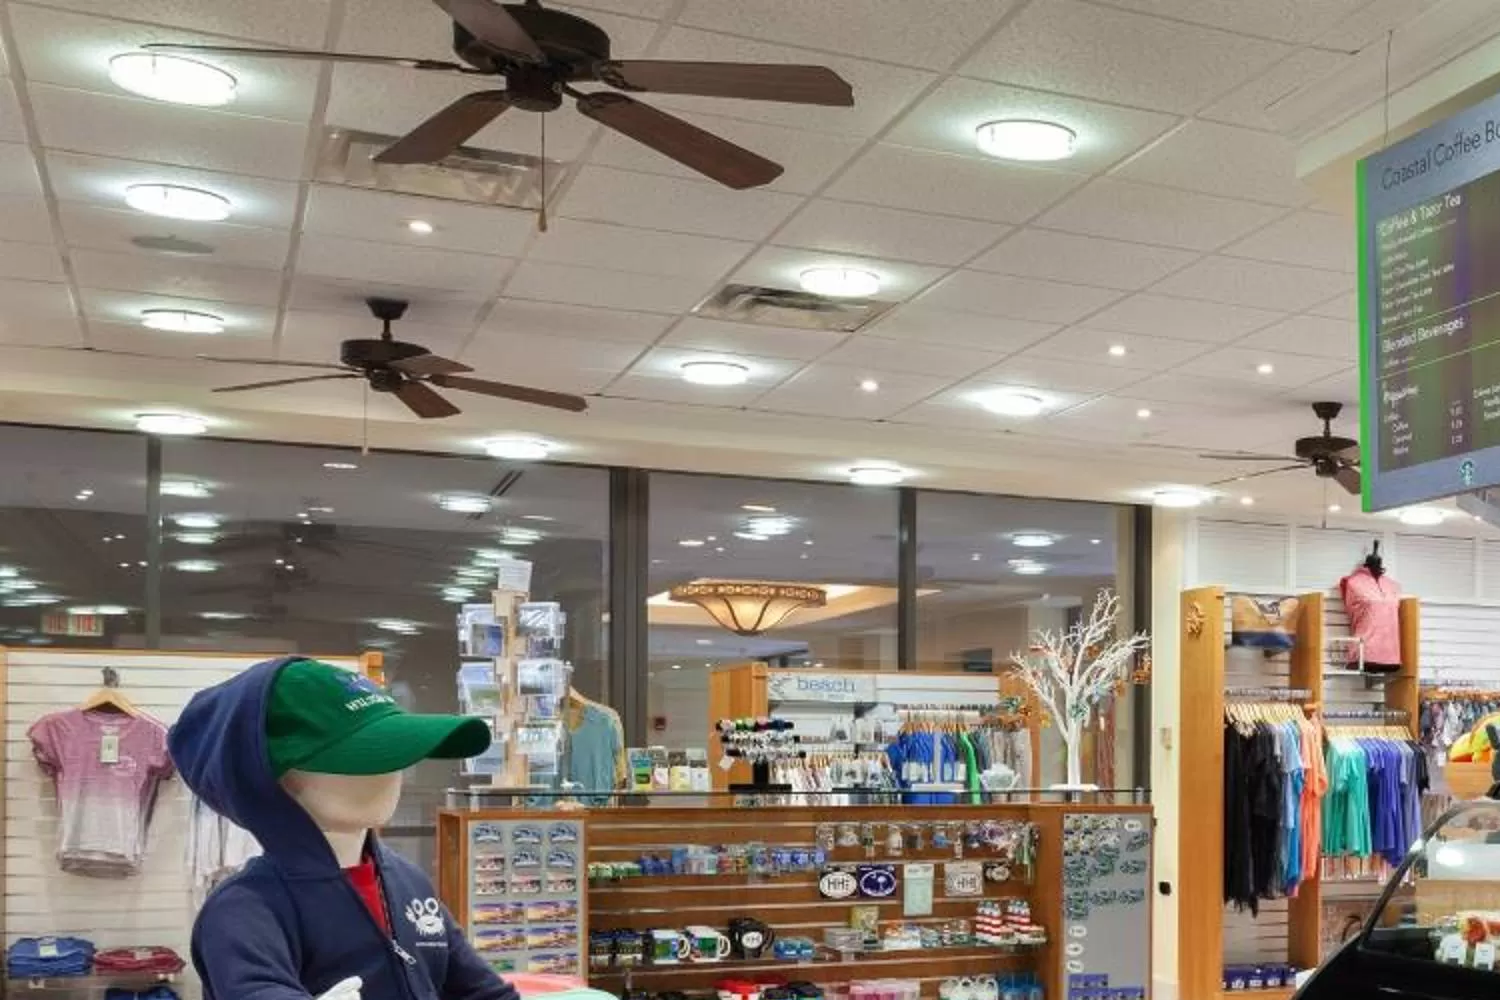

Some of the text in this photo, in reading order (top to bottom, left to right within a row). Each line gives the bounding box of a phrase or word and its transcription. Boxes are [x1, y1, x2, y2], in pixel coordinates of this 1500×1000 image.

[1381, 150, 1432, 190] Coastal
[1433, 130, 1480, 166] Coffee
[1444, 193, 1461, 208] Tea
